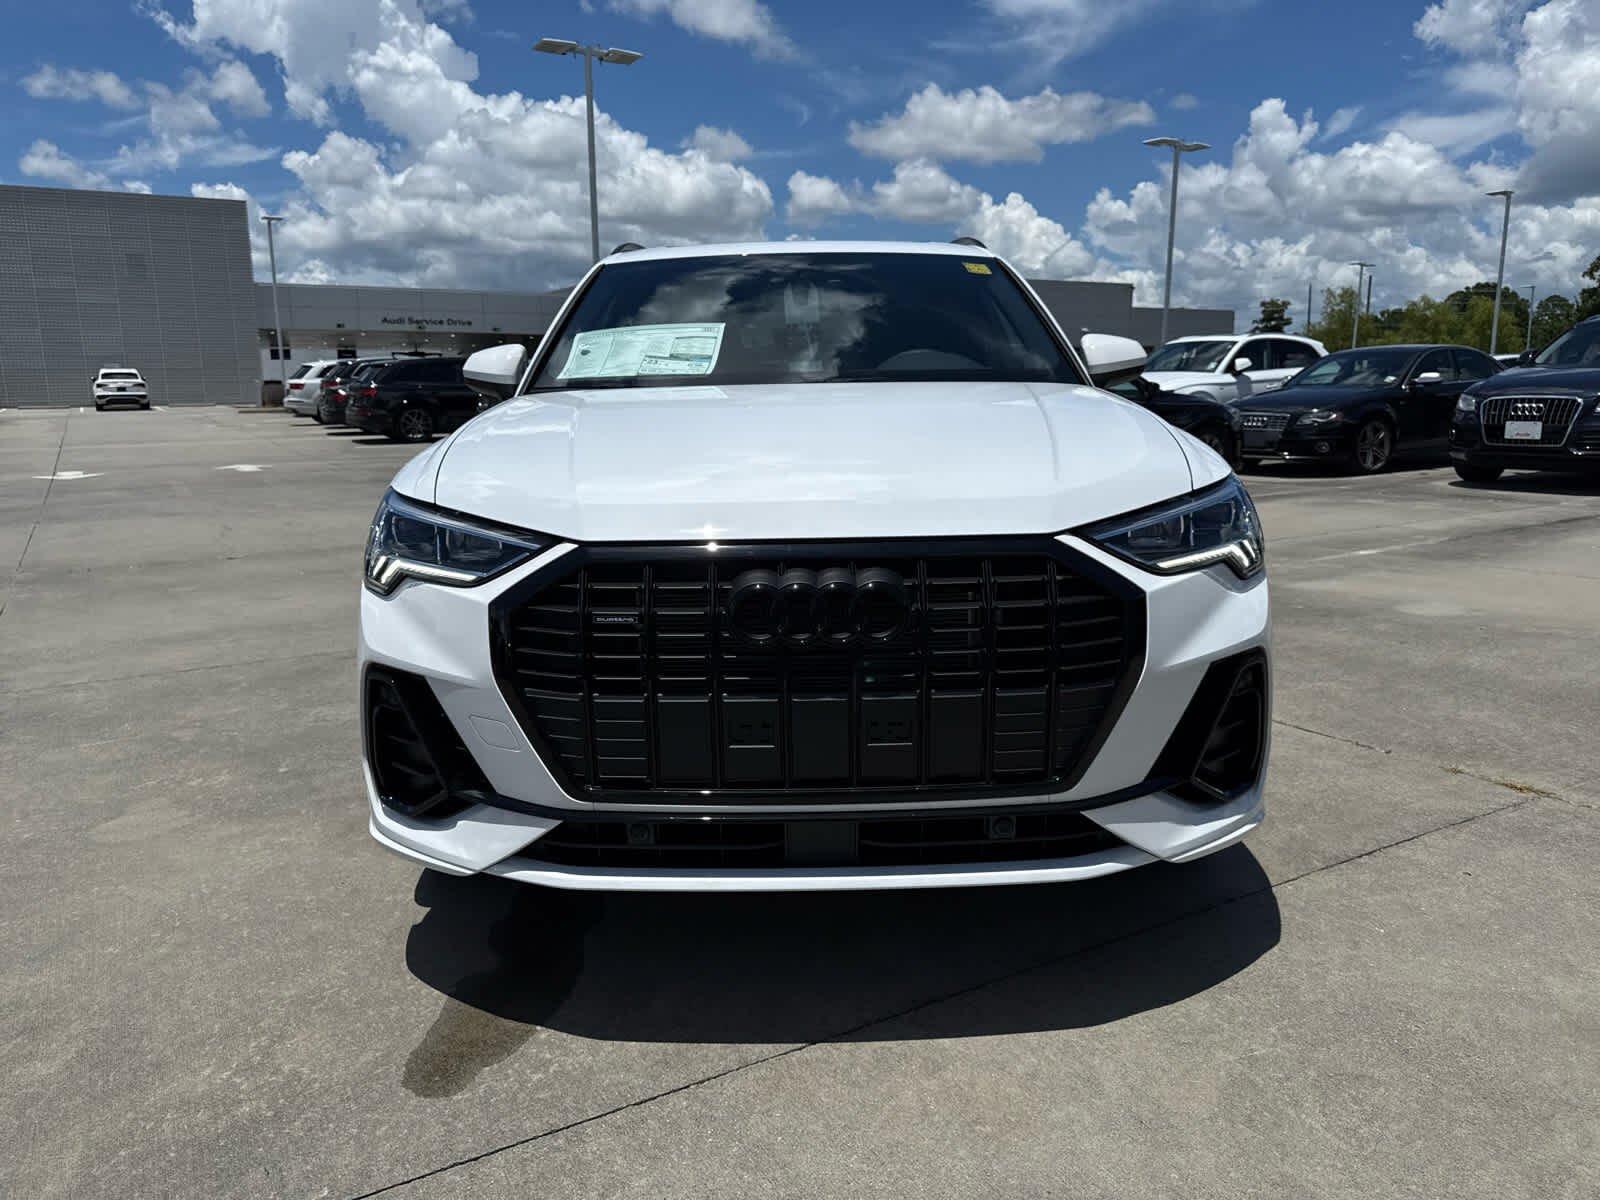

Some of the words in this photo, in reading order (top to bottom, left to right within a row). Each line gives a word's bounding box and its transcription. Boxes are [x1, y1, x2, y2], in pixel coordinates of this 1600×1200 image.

[382, 316, 405, 325] Audi
[408, 316, 443, 326] Service
[447, 318, 472, 326] Drive
